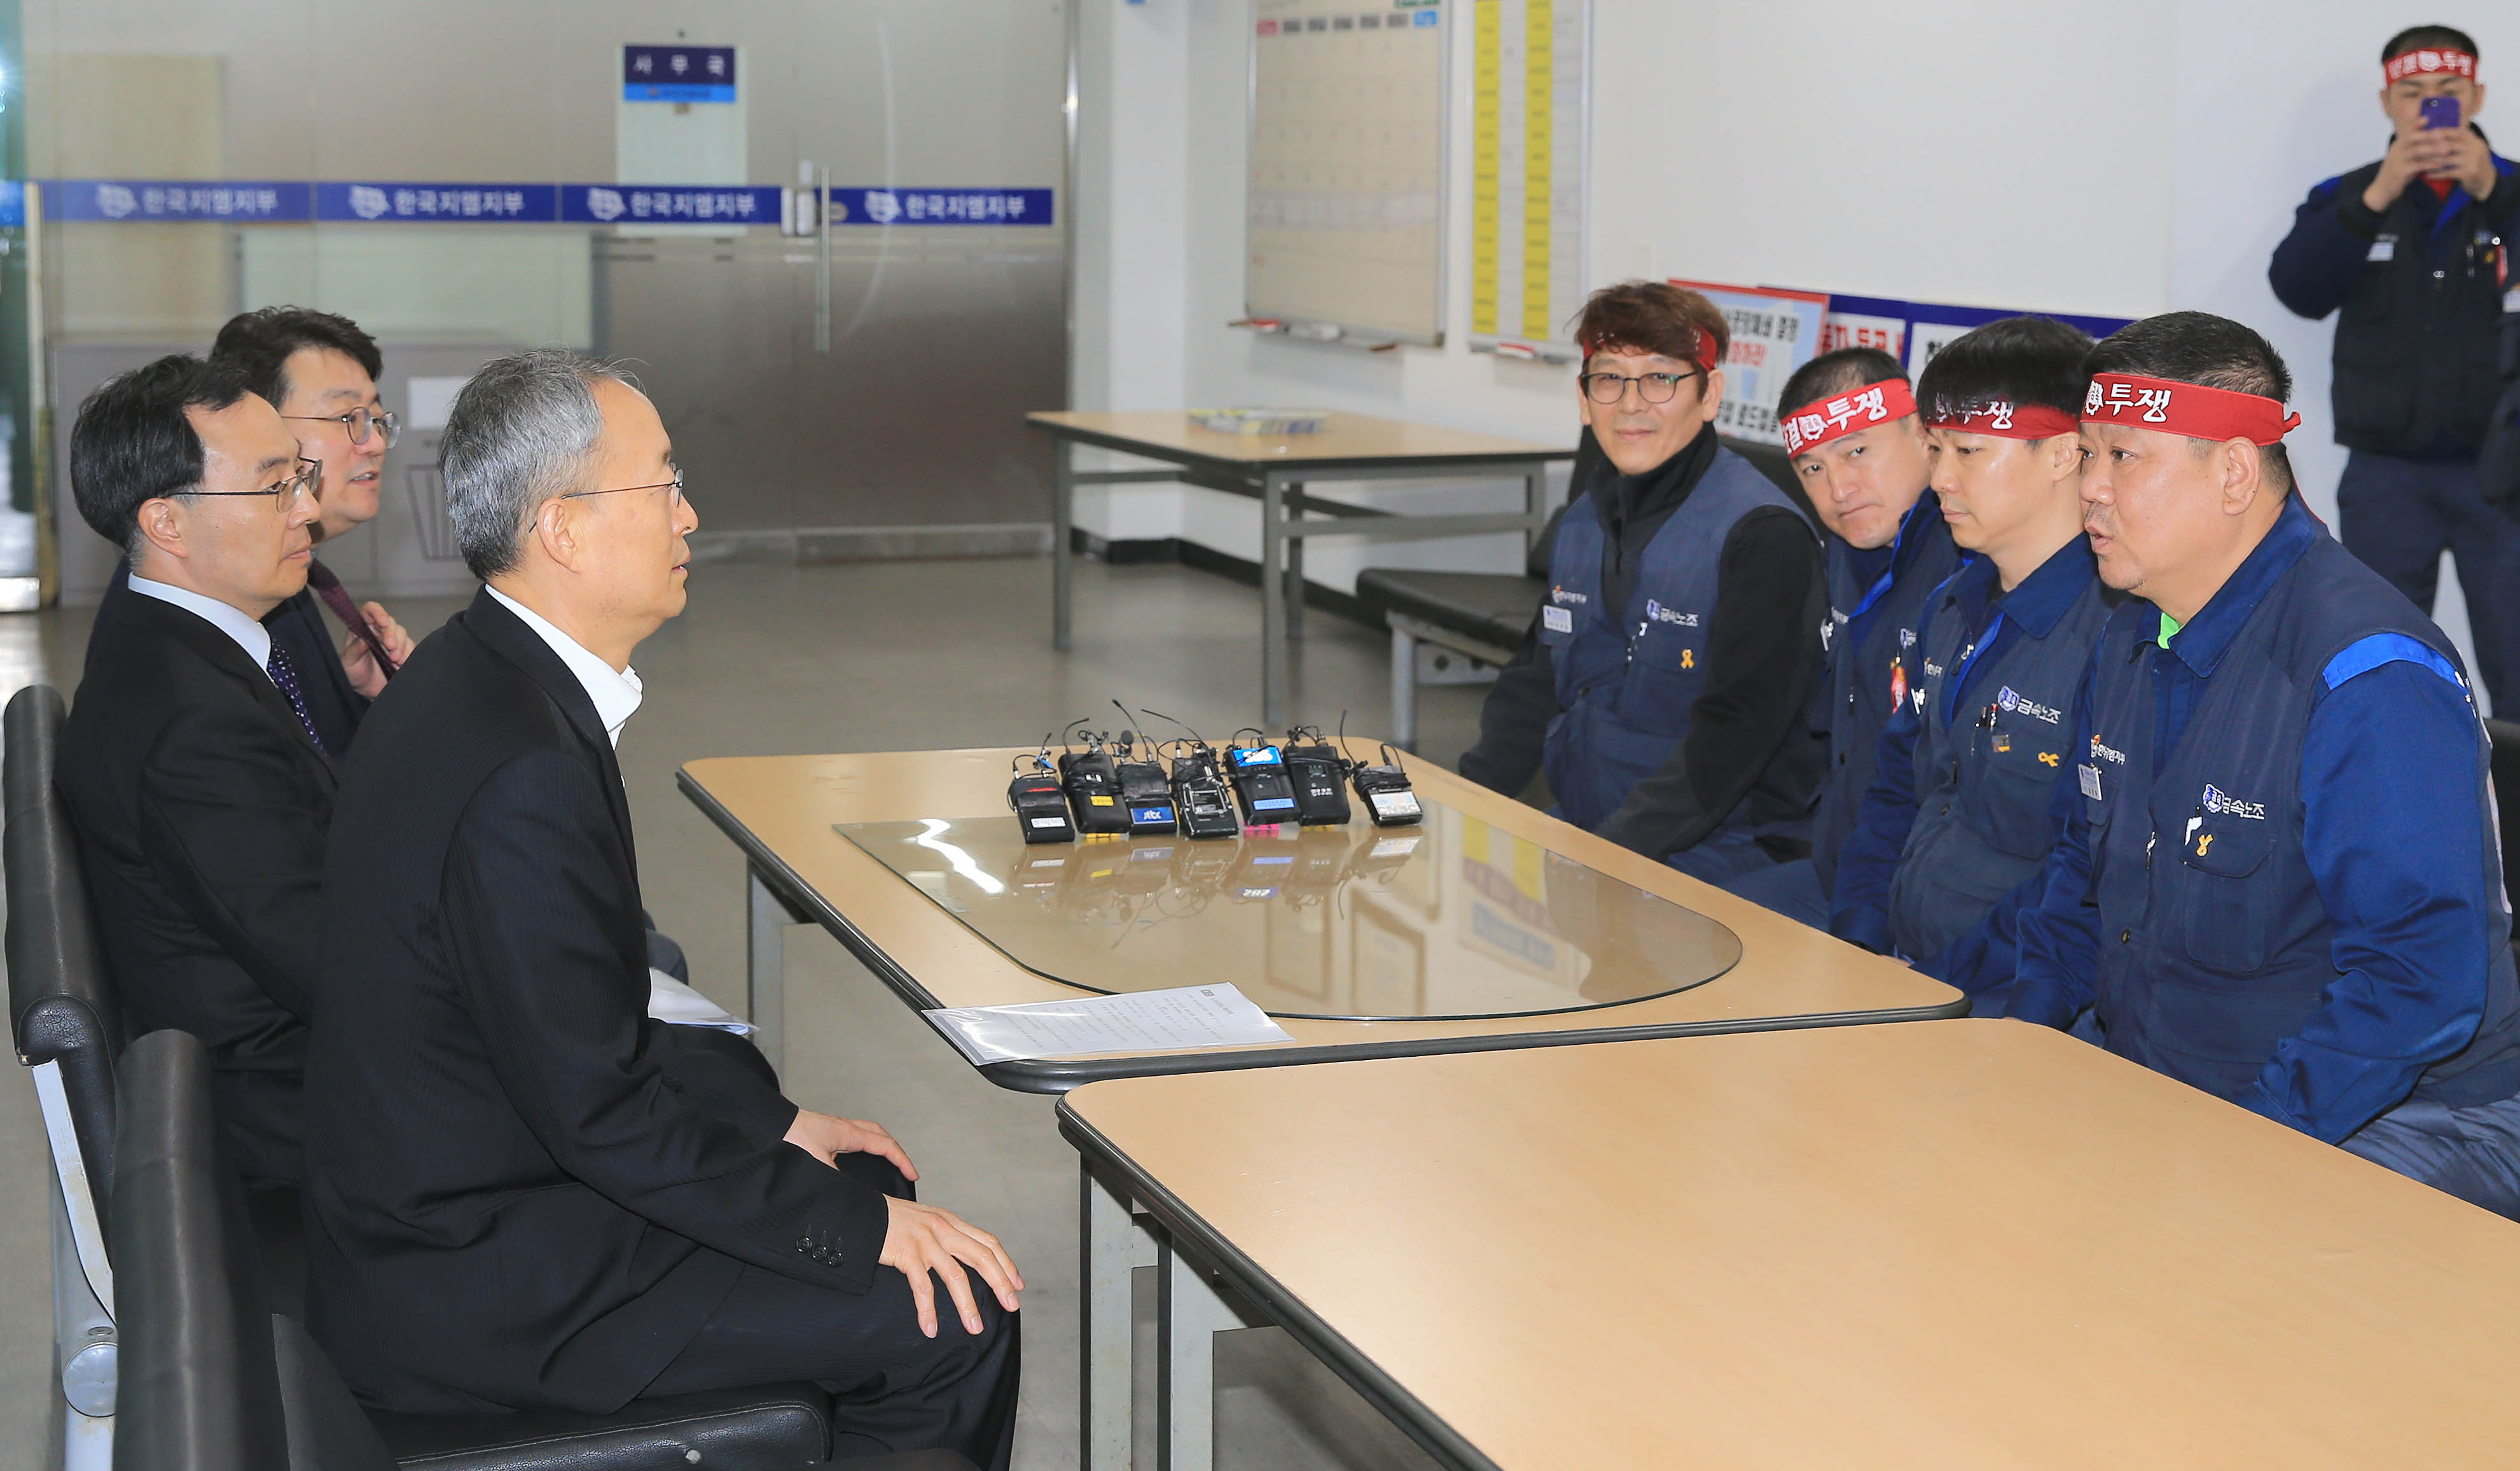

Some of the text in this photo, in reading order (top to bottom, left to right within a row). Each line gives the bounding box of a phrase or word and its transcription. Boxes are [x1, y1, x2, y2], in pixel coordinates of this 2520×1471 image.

[142, 187, 279, 214] 한국지엠지부
[394, 189, 524, 216] 한국지엠지부
[631, 192, 757, 218] 한국지엠지부
[906, 193, 1026, 220] 한국지엠지부
[1826, 387, 1888, 431] 투쟁
[2105, 382, 2172, 422] 투쟁
[2016, 697, 2061, 725] 금속노조
[2222, 797, 2265, 819] 금속노조
